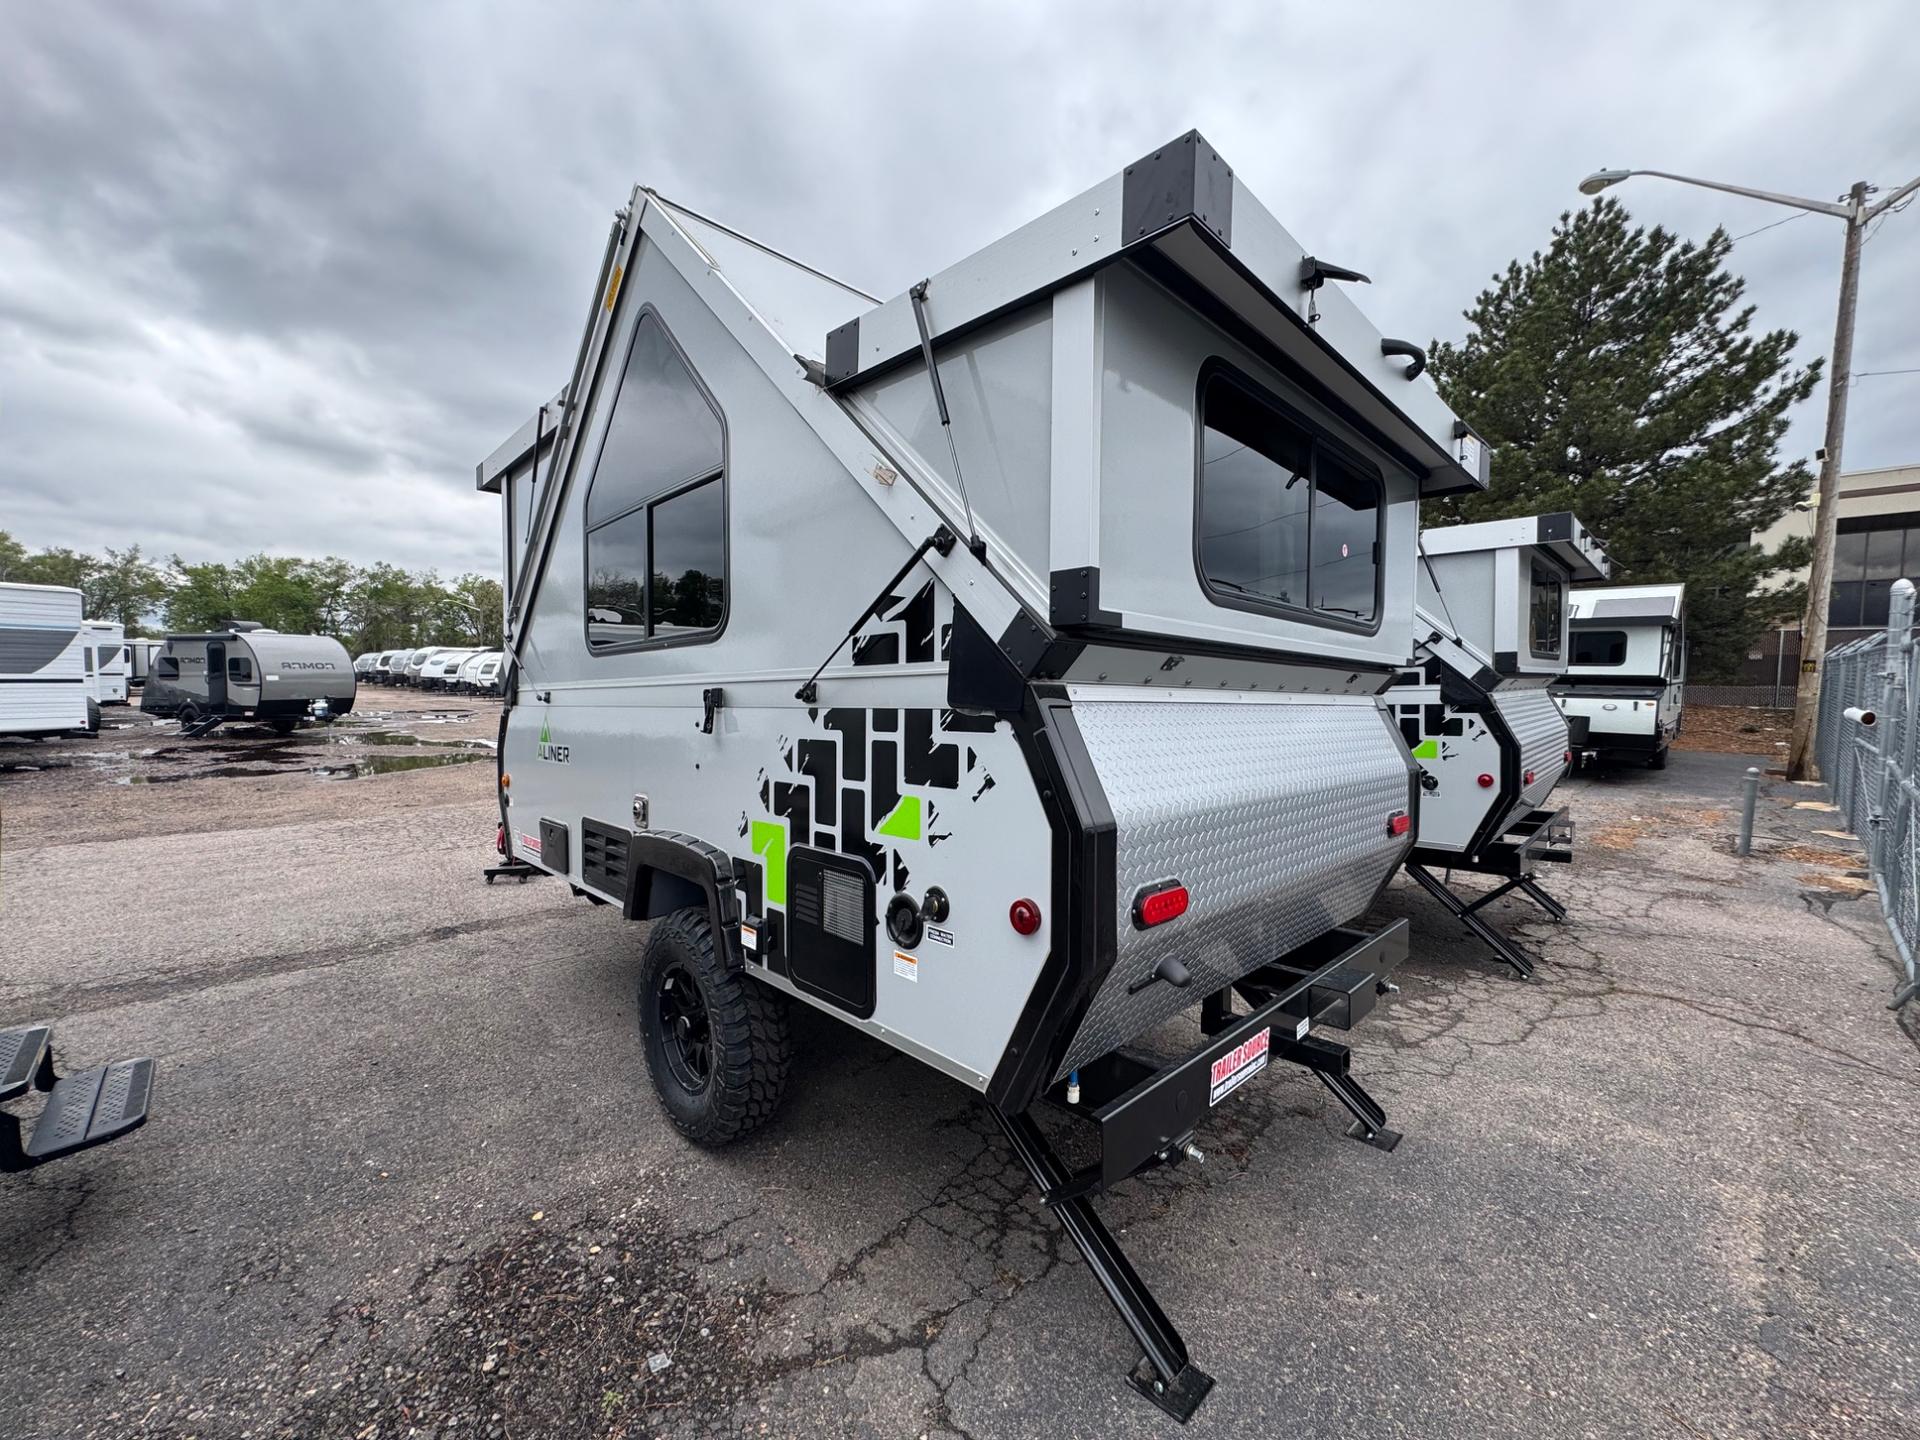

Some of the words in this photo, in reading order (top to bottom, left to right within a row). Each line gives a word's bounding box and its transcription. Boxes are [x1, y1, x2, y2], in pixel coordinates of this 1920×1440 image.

[281, 662, 336, 671] ARMOR
[537, 744, 570, 763] ALINER
[1212, 1047, 1242, 1086] TRAILER
[1243, 1029, 1269, 1064] SOURCE
